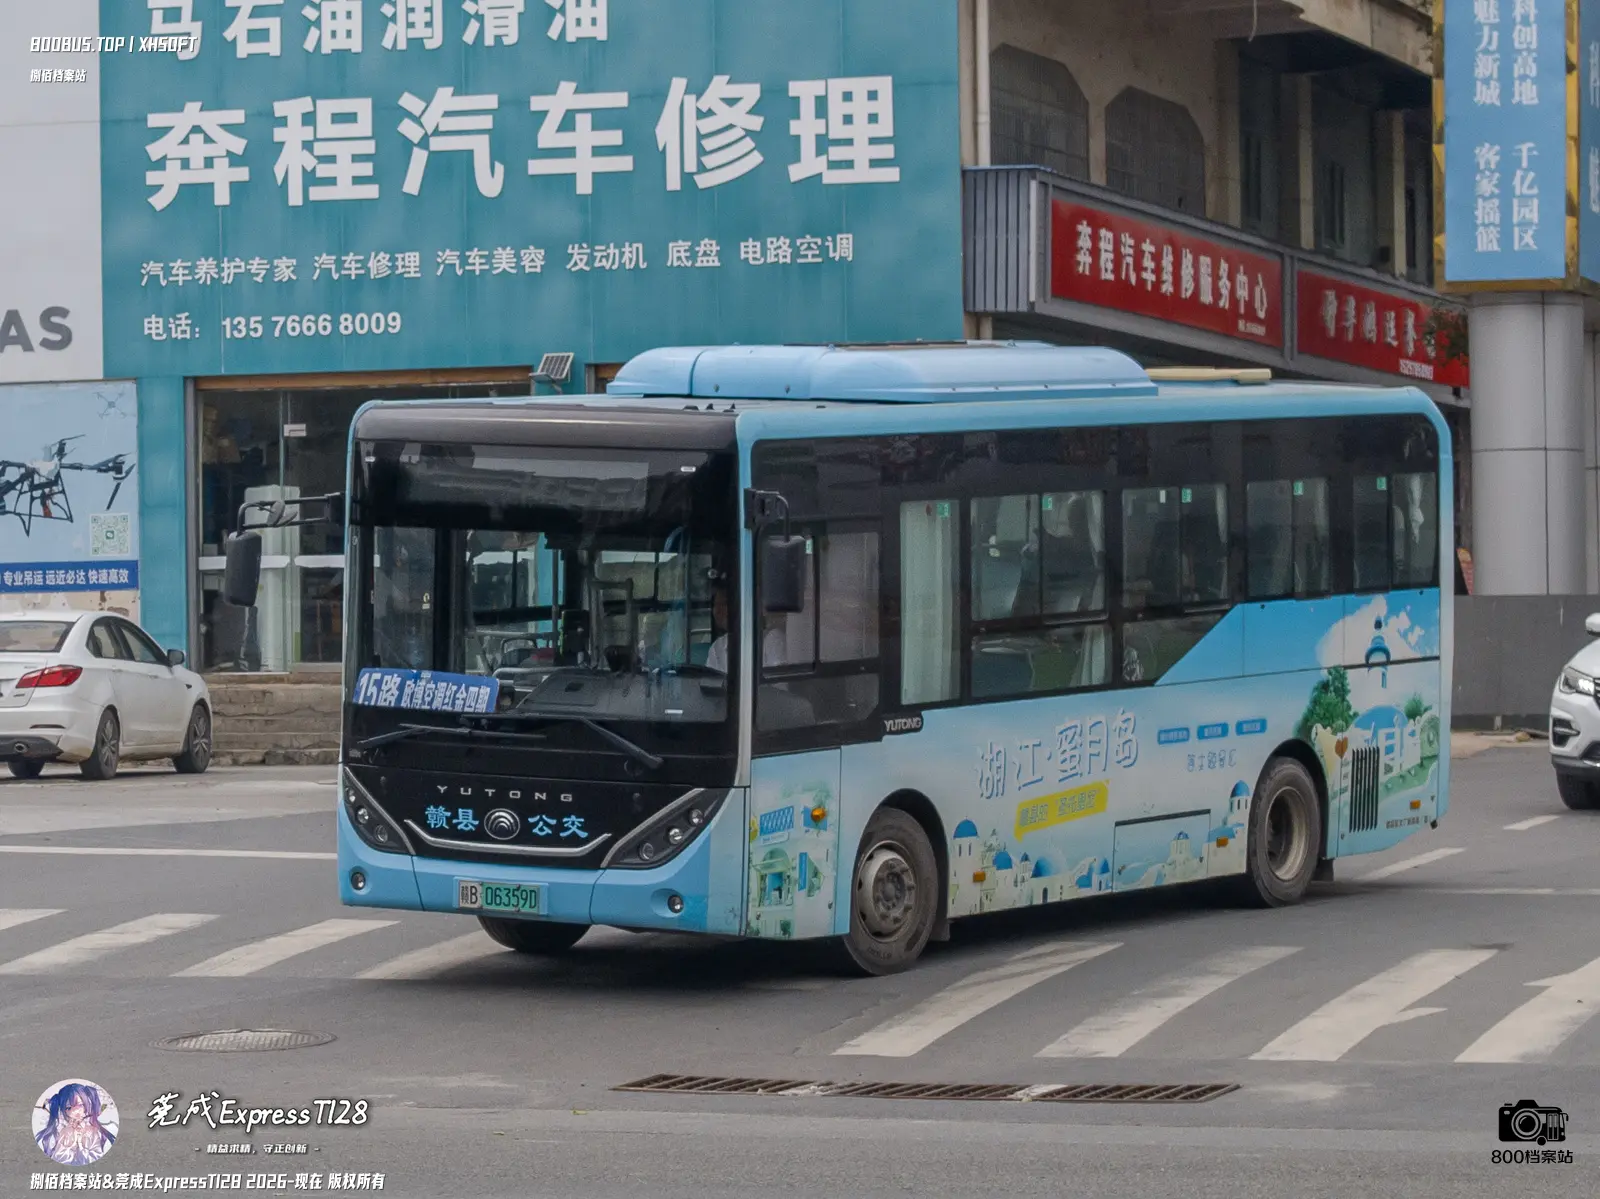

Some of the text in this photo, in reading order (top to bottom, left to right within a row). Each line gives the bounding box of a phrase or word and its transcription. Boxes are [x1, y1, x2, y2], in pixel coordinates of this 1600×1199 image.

[149, 0, 608, 60] 马石油润滑油
[145, 75, 900, 212] 奔程汽车修理
[1474, 143, 1501, 253] 客家摇篮
[1512, 142, 1539, 250] 千亿园区
[140, 233, 854, 287] 汽车养护专家 汽车修理 汽车美容 发动机 底盘 电路空调
[1076, 220, 1268, 320] 奔程汽车维修服务中心
[222, 316, 263, 340] 135
[272, 314, 333, 338] 7666
[339, 312, 402, 336] 8009
[3, 568, 129, 586] 专业吊运 远近必达 快速高效
[358, 672, 402, 707] 15路
[884, 716, 922, 732] YUTONG
[437, 785, 573, 802] YUTONG
[425, 805, 589, 839] 赣县 公交
